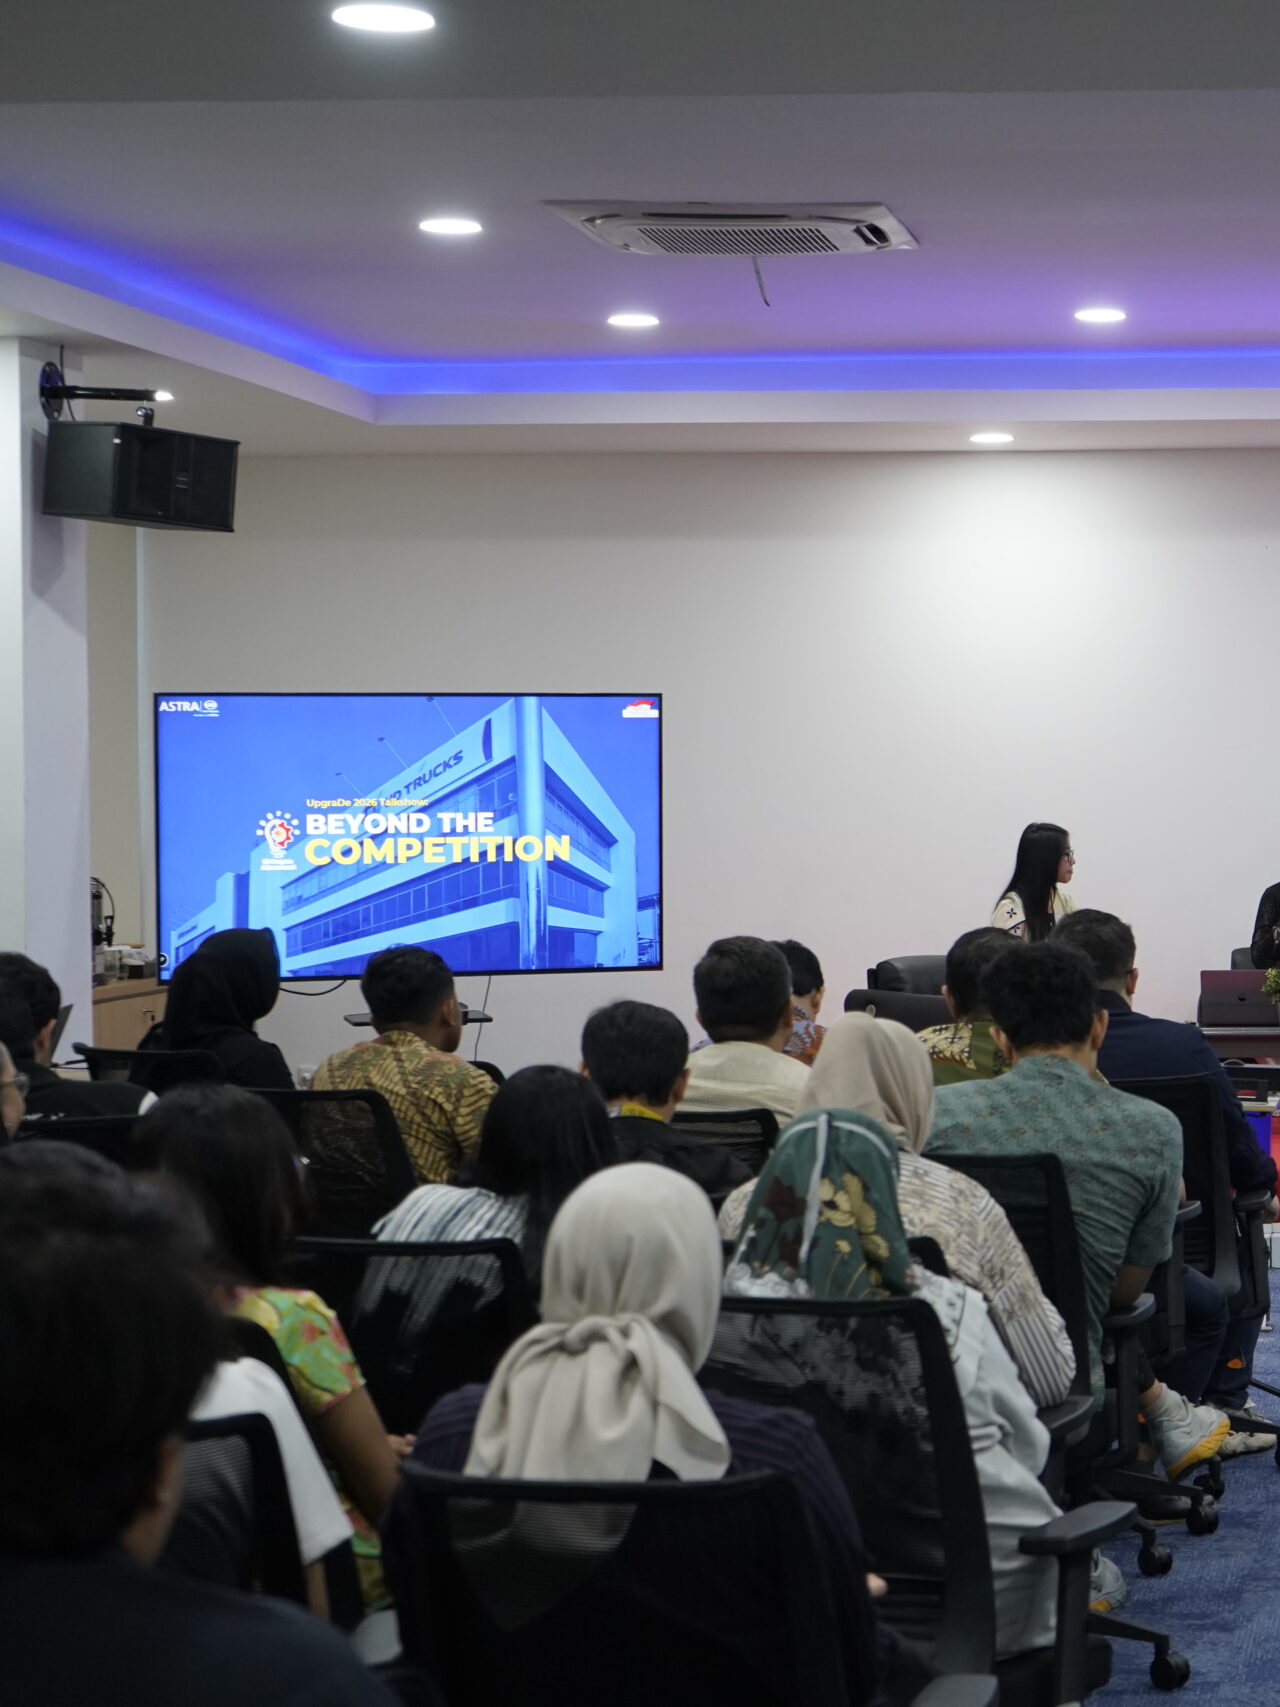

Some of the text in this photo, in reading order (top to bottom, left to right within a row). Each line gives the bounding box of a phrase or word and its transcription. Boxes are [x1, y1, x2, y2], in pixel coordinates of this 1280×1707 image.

[159, 701, 200, 712] ASTRA
[403, 749, 464, 794] TRUCKS
[306, 798, 429, 808] UpgraDe 2026 Talkshow:
[306, 813, 431, 835] BEYOND
[437, 811, 495, 833] THE
[304, 834, 570, 866] COMPETITION
